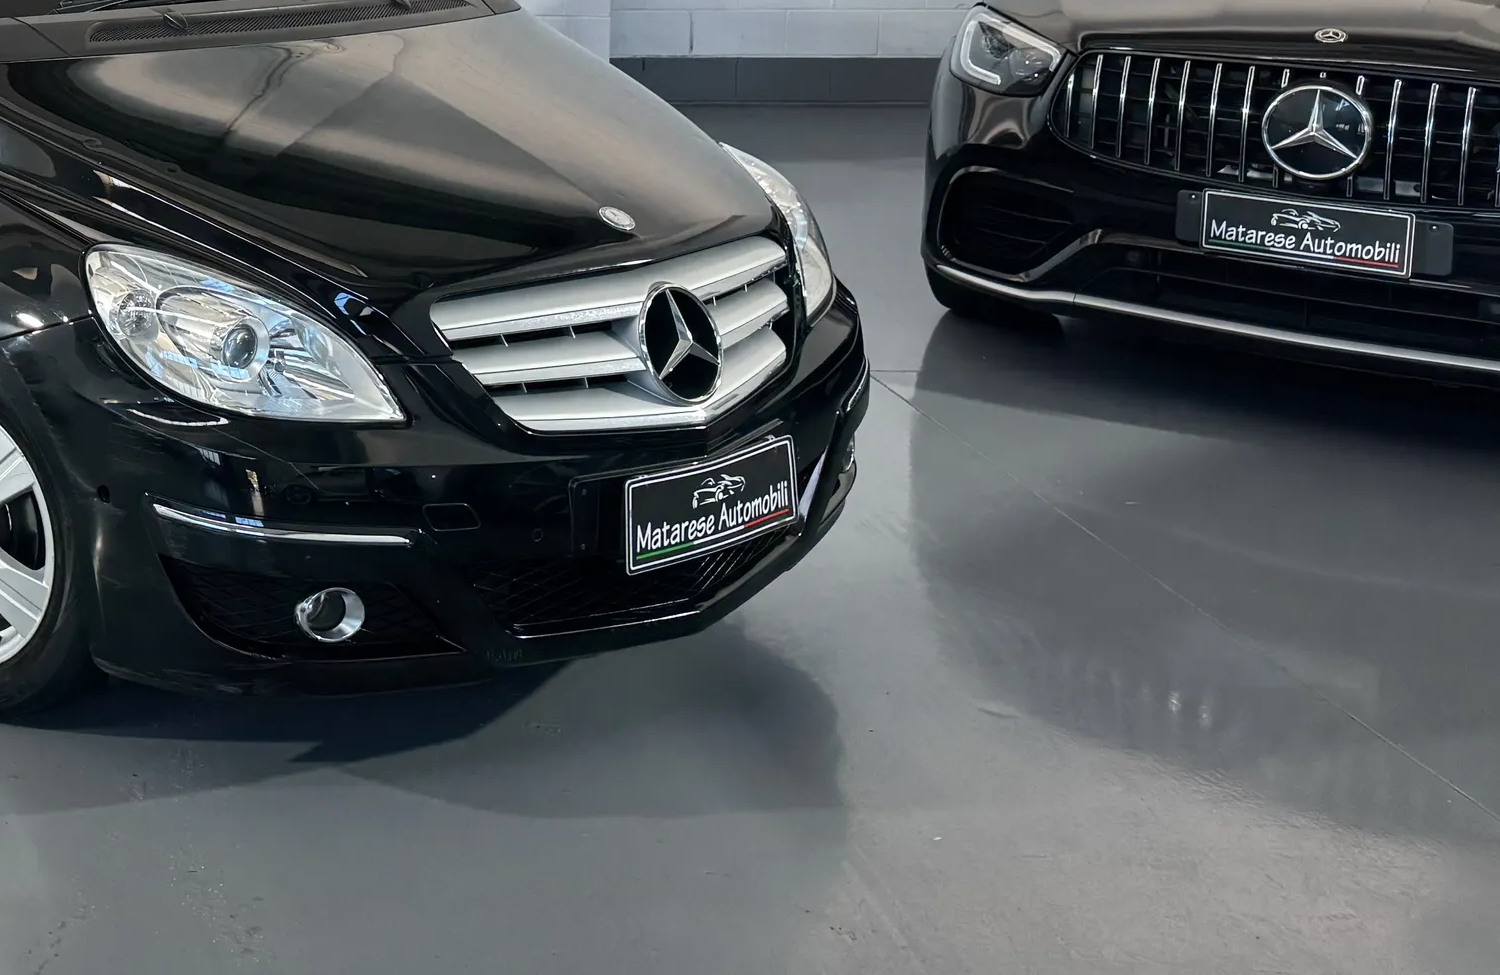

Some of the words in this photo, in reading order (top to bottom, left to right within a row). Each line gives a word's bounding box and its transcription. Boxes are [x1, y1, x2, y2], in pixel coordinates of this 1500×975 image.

[1210, 219, 1296, 249] Matarese
[1300, 232, 1400, 264] Automobili
[636, 514, 715, 553] Matarese
[718, 480, 788, 530] Automobili
